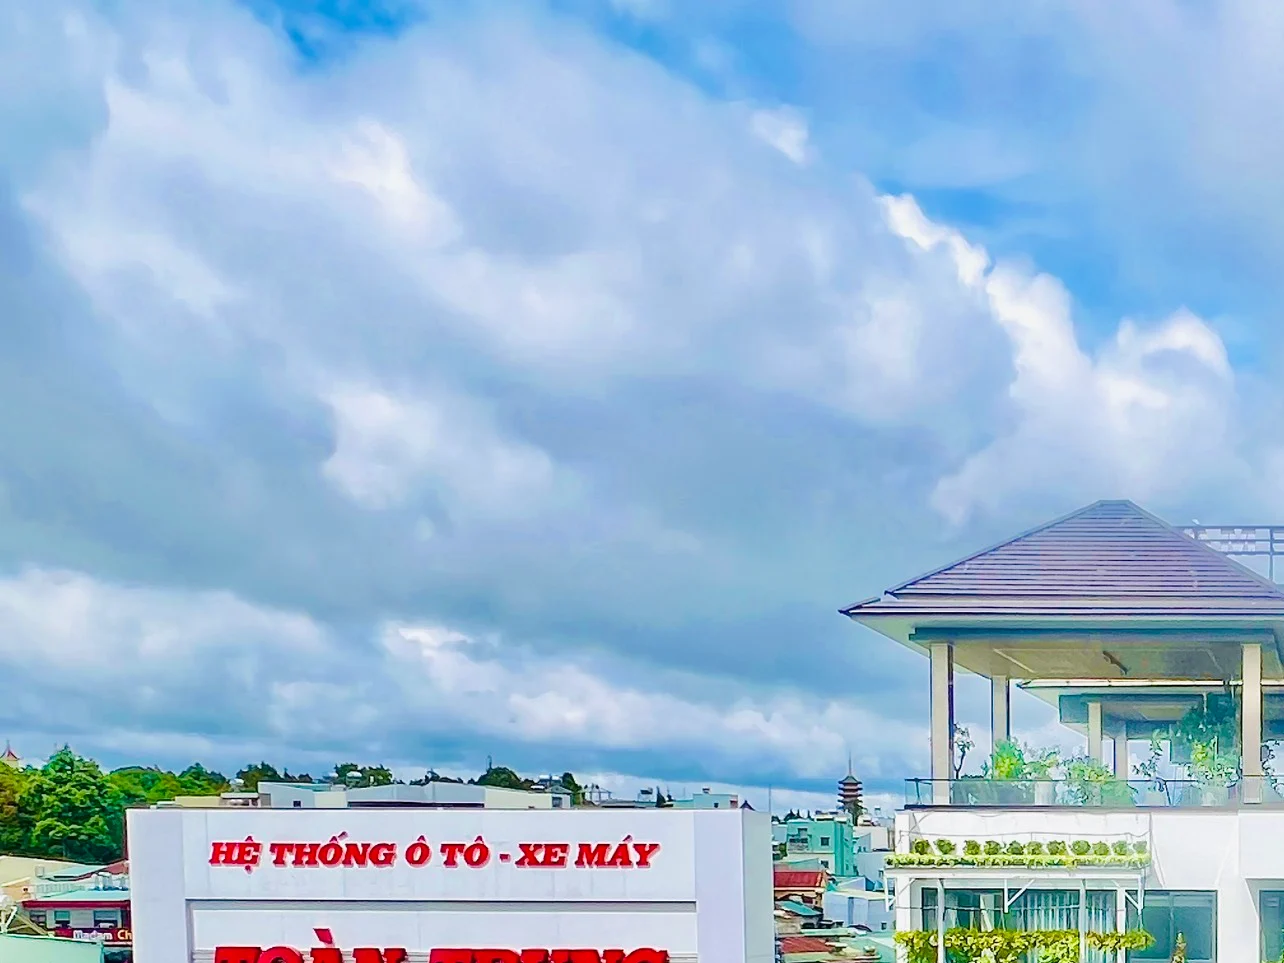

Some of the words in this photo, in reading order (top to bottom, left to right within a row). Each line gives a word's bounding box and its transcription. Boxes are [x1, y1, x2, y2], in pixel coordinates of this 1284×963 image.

[209, 835, 262, 874] HỆ
[270, 831, 397, 867] THỐNG
[405, 835, 431, 867] Ô
[441, 835, 490, 867] TÔ
[515, 843, 569, 867] XE
[575, 835, 660, 867] MÁY
